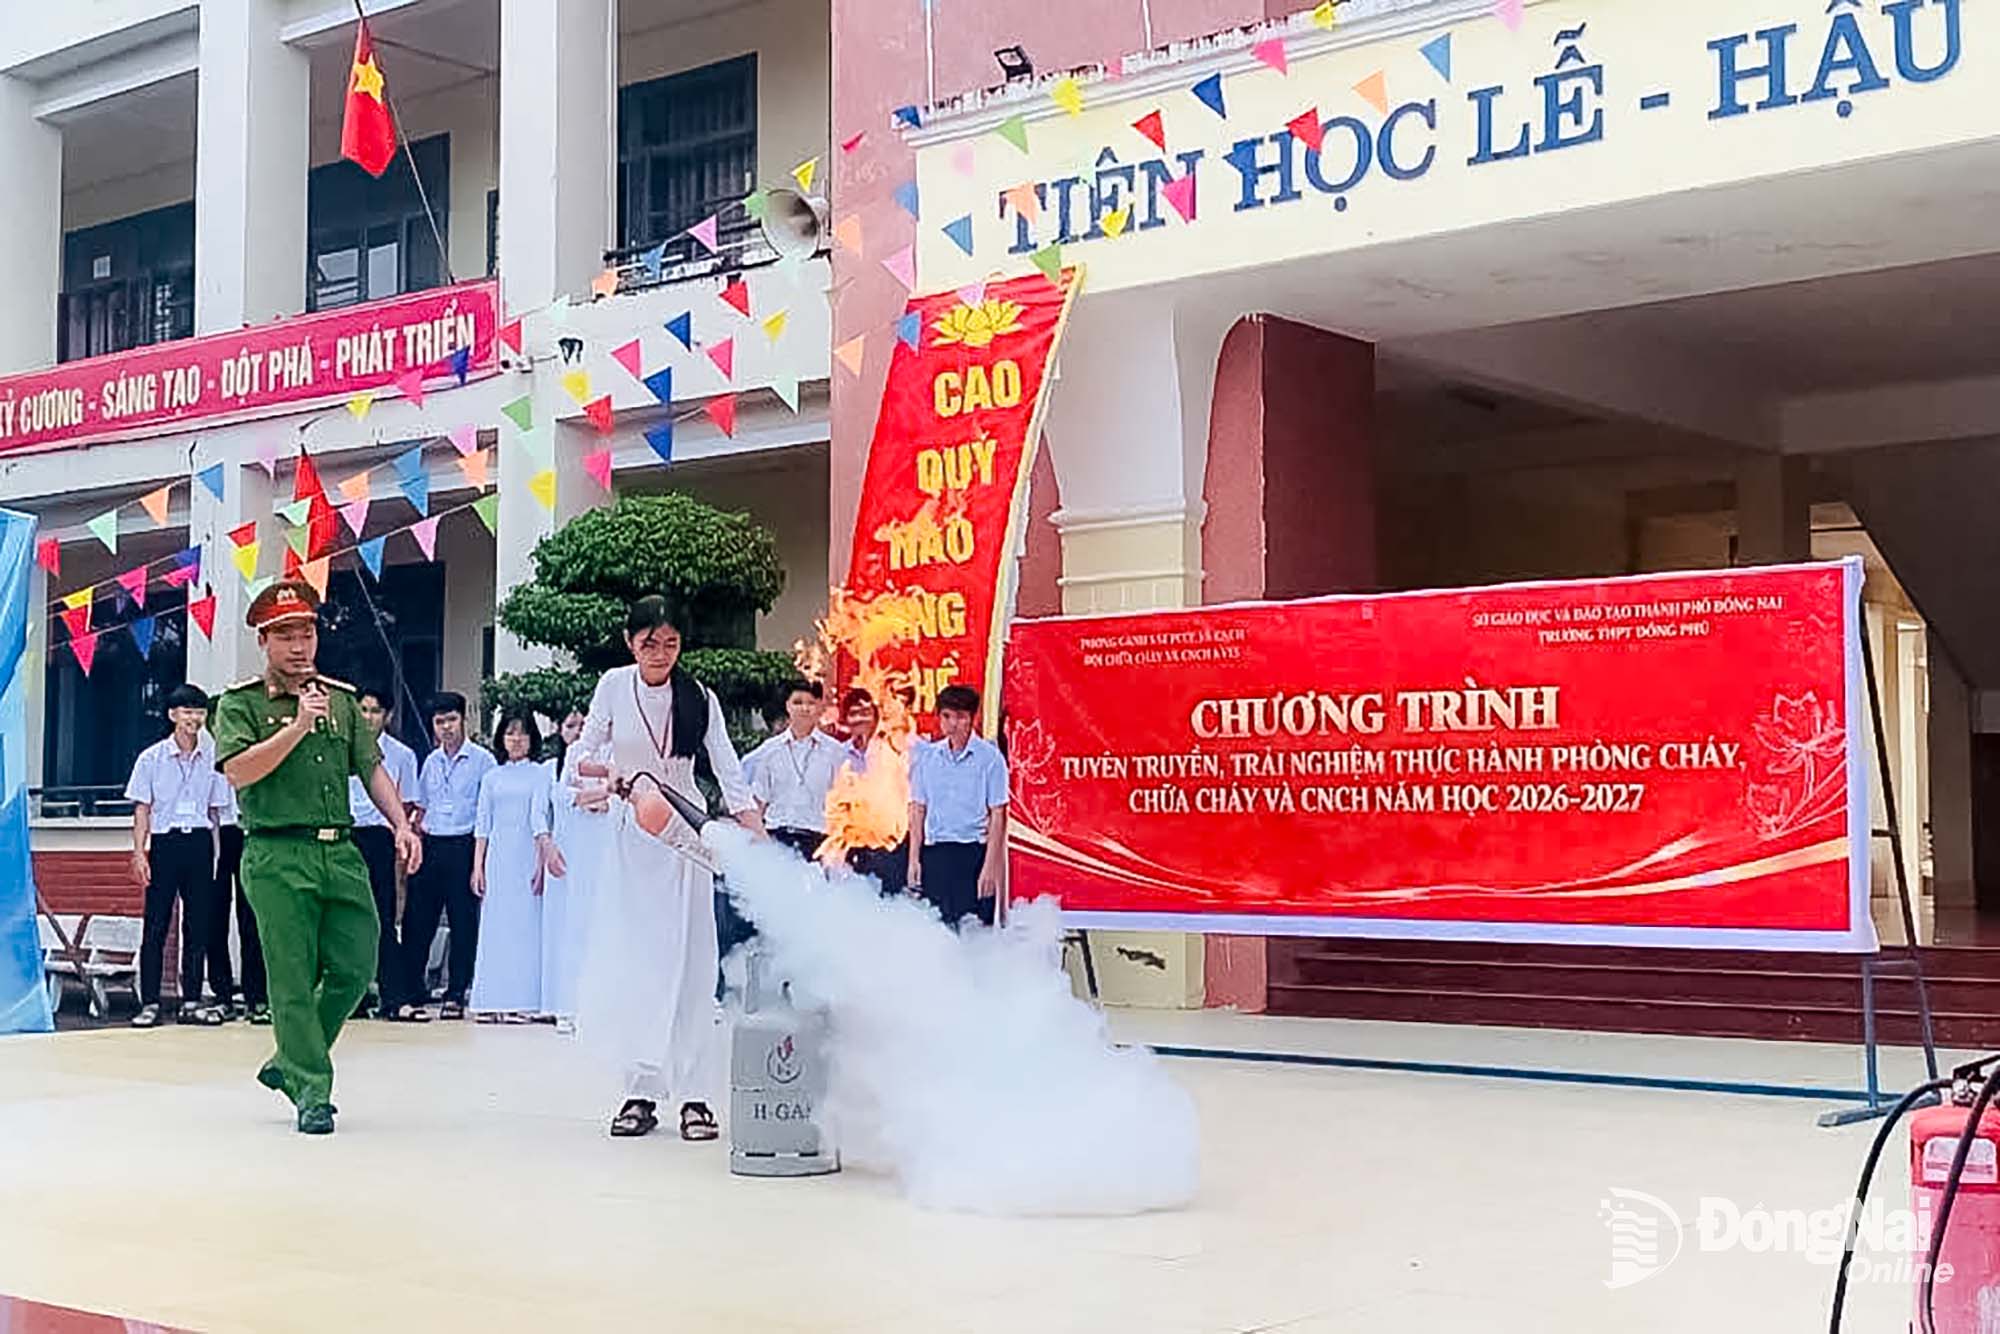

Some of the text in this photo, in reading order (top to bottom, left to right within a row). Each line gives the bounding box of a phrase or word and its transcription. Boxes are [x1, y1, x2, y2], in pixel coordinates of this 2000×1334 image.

[999, 146, 1204, 254] TIÊN
[1232, 98, 1436, 212] HỌC
[1466, 22, 1603, 166] LỄ
[1707, 0, 1965, 119] HẬU
[102, 371, 157, 420] SÁNG
[162, 365, 200, 417] TẠO
[220, 347, 264, 404] ĐỘT
[268, 335, 313, 392] PHÁ
[336, 323, 397, 379] PHÁT
[403, 298, 475, 368] TRIỂN
[933, 360, 1021, 418] CAO
[1190, 676, 1560, 738] CHƯƠNG TRÌNH
[1060, 735, 1747, 781] TUYÊN TRUYỀN, TRẢI NGHIỆM THỰC HÀNH PHÒNG CHÁY,
[1129, 781, 1645, 817] CHỮA CHÁY VÀ CNCH NĂM HỌC 2026-2027
